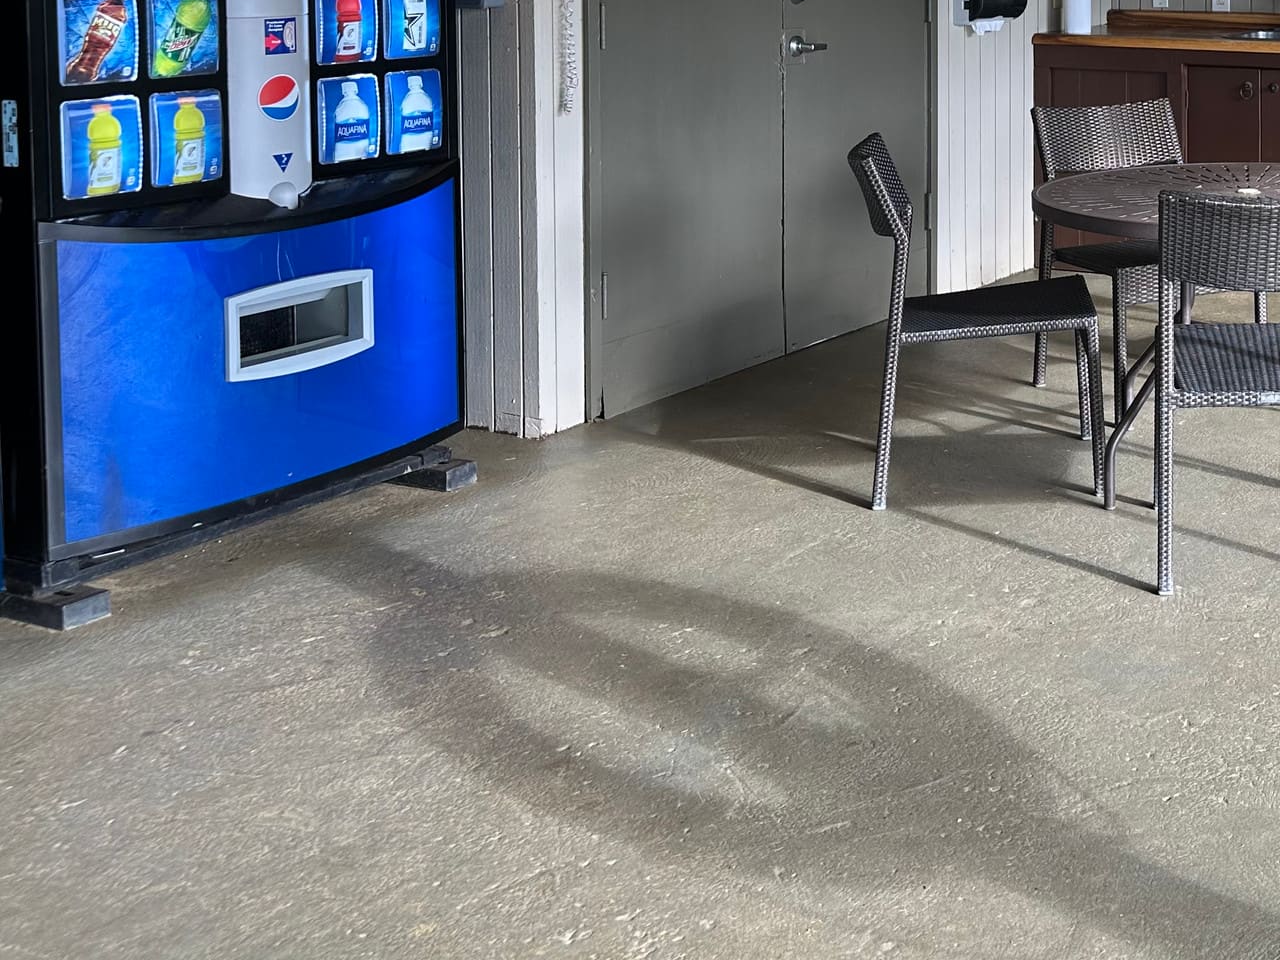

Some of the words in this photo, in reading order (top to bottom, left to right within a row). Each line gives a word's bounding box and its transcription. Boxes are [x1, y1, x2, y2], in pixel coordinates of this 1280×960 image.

[91, 15, 121, 38] MUG
[403, 116, 432, 129] AQUAFINA
[337, 124, 368, 137] AQUAFINA
